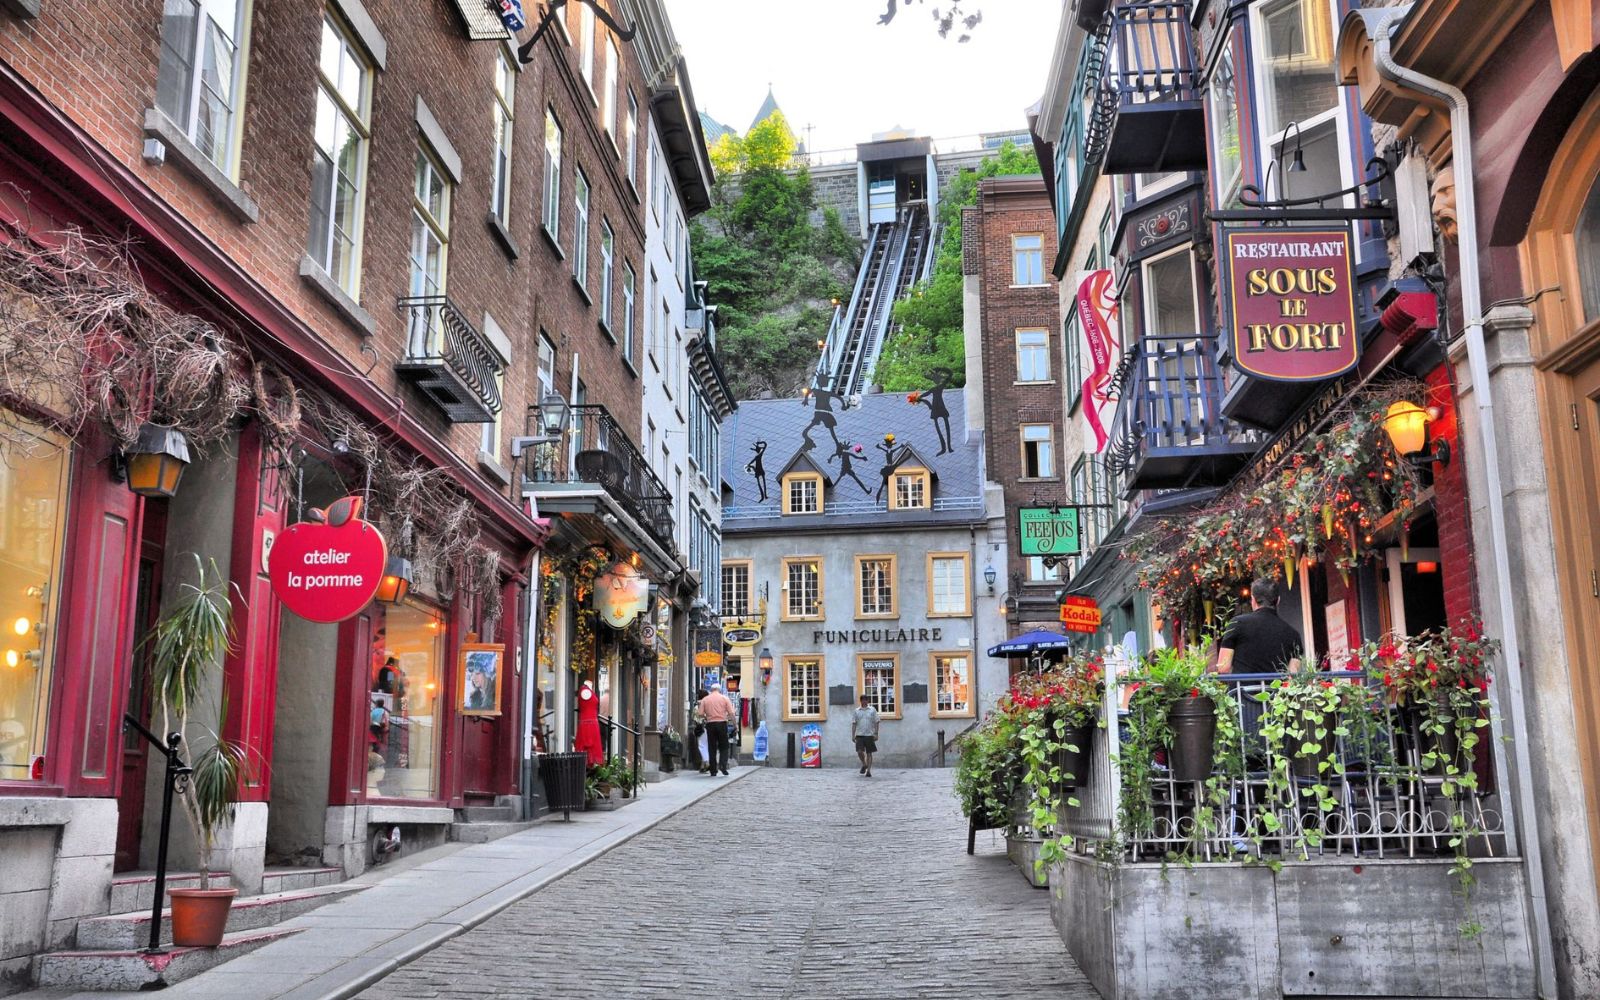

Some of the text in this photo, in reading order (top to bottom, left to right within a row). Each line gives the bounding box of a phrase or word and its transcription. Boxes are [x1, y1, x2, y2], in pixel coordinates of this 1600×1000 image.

[1234, 241, 1344, 258] RESTAURANT
[1246, 267, 1337, 297] SOUS
[1080, 299, 1094, 327] QUÉBEC
[1279, 298, 1308, 317] LE
[1245, 321, 1346, 352] FORT
[1025, 519, 1074, 553] FEEJO'S
[303, 548, 351, 565] atelier
[288, 571, 363, 591] la pomme
[1063, 607, 1100, 622] Kodak
[813, 628, 942, 644] FUNICULAIRE
[864, 661, 893, 669] SOUVENIRS
